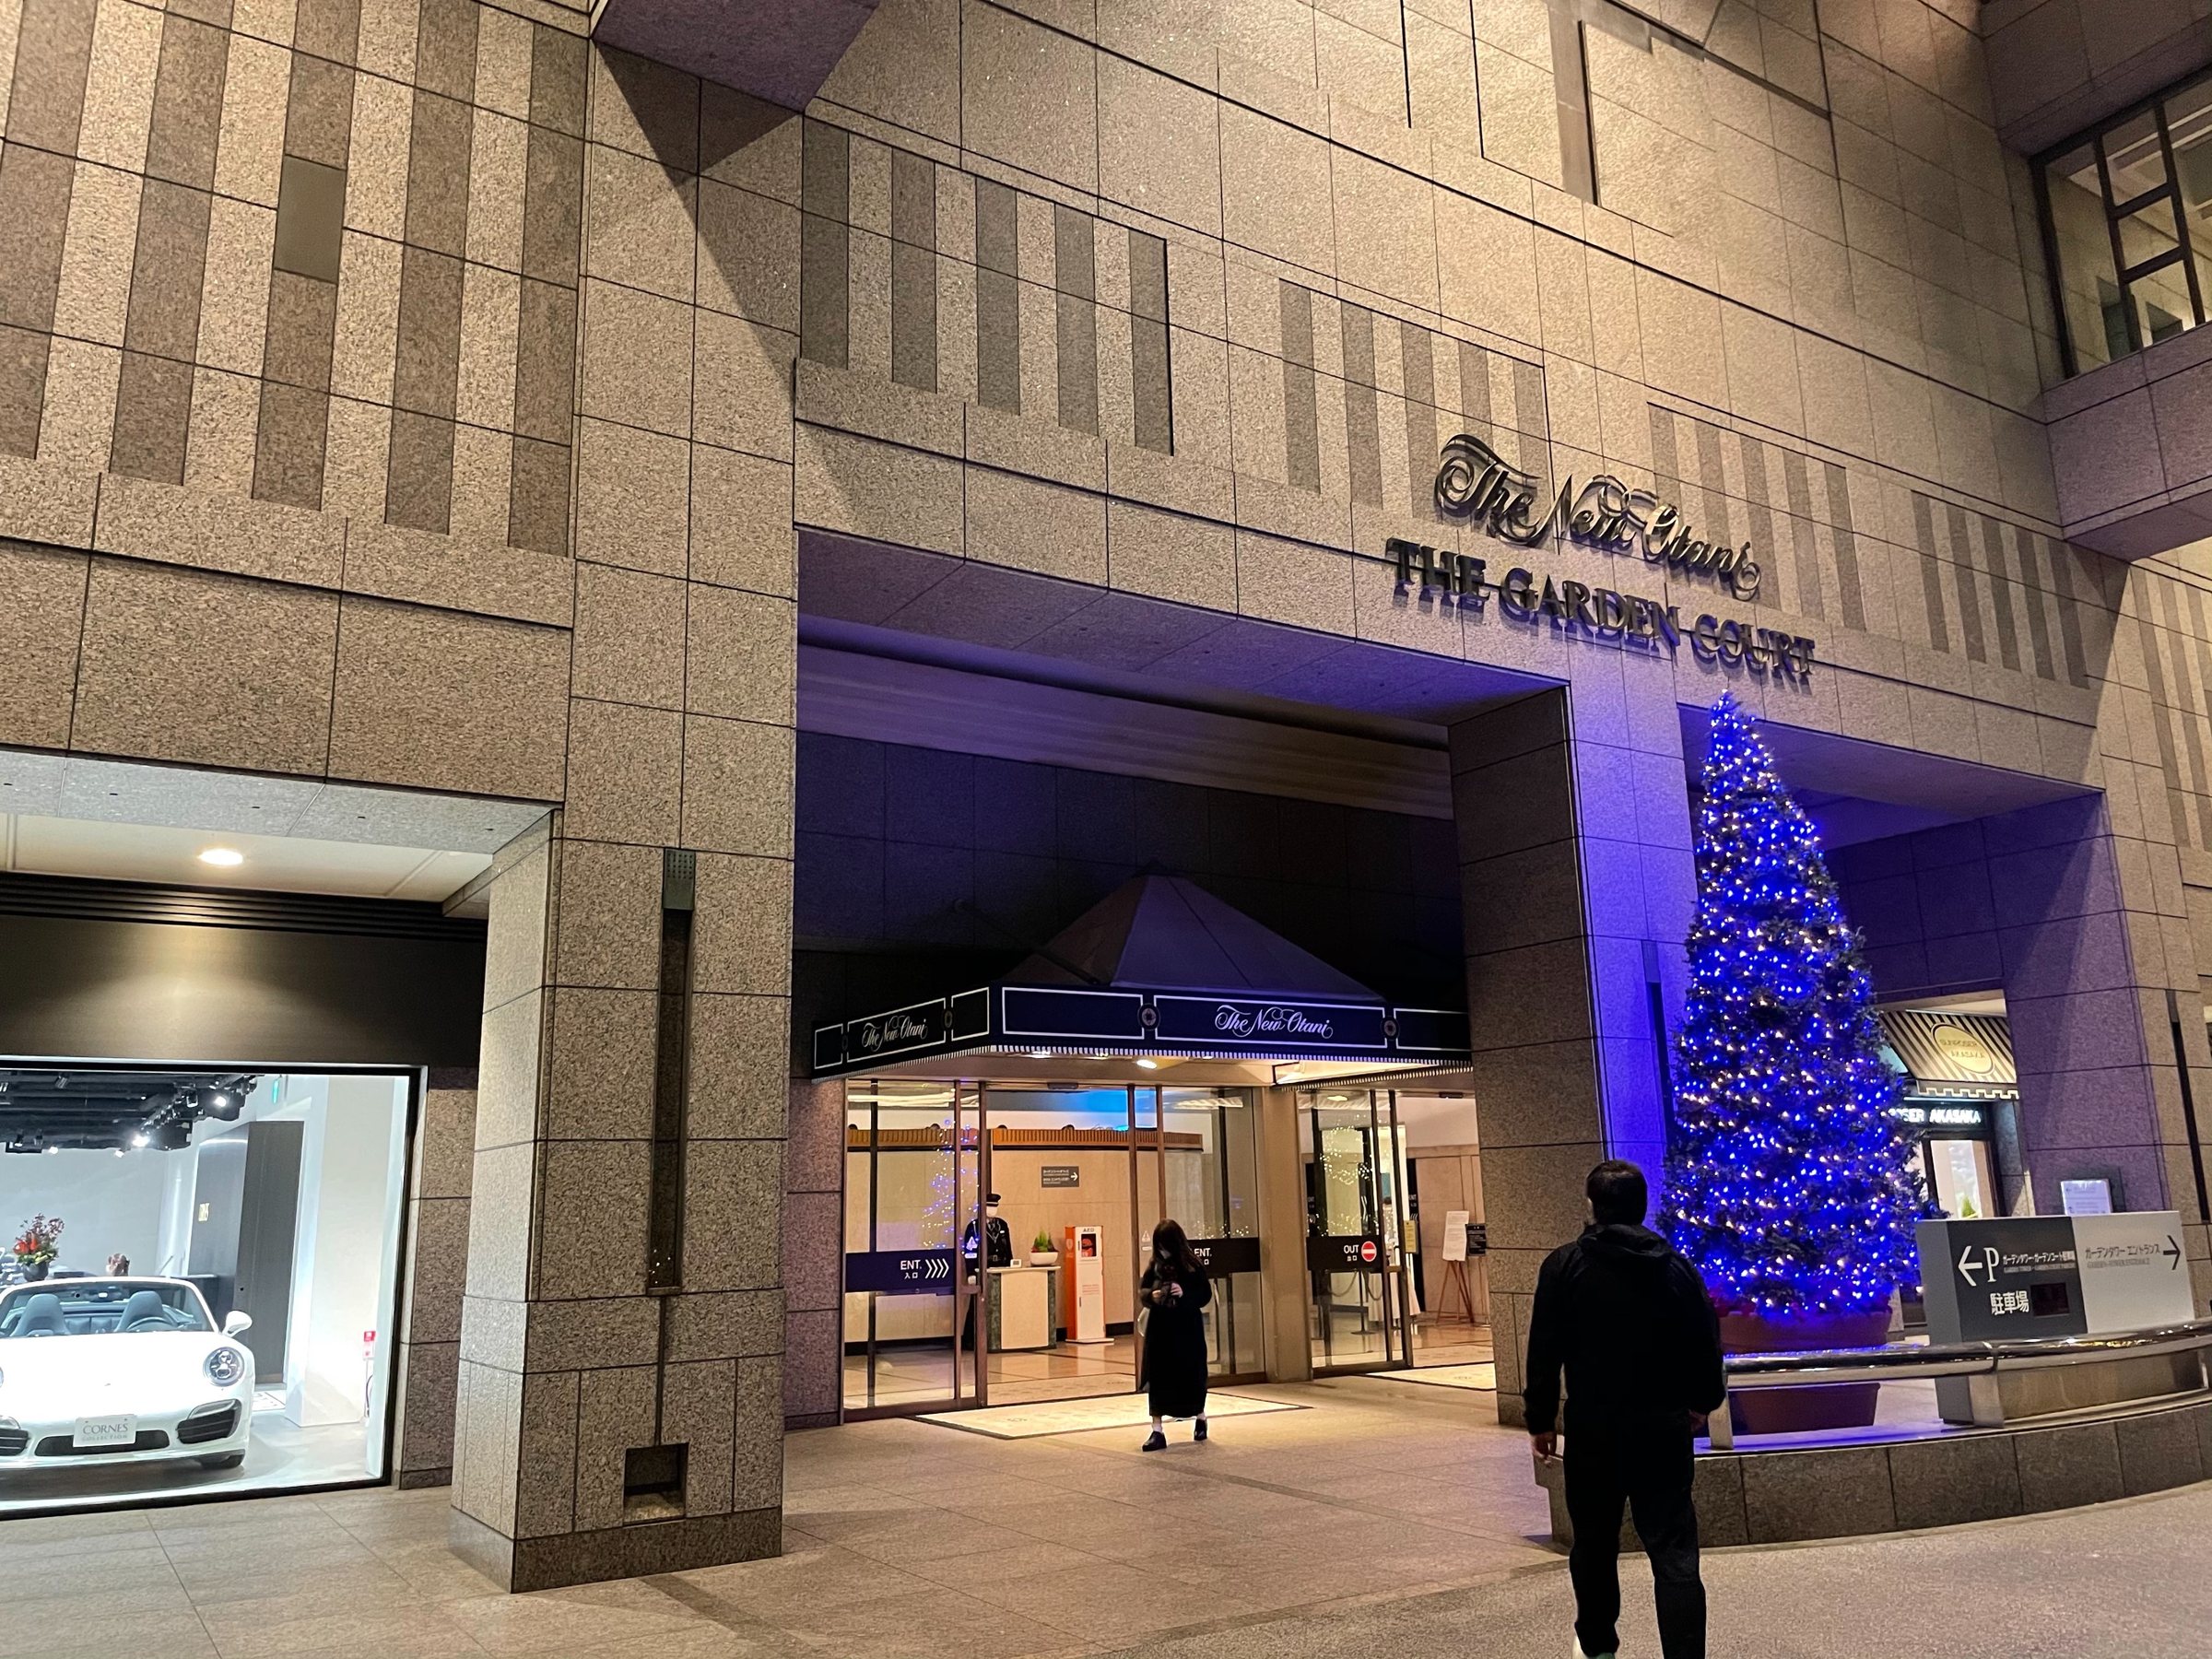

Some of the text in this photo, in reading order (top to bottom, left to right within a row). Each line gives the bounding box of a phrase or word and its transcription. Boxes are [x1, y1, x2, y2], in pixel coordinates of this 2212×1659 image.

[1435, 433, 1541, 518] The
[1641, 502, 1762, 601] Otani
[1385, 537, 1816, 675] THE GARDEN COURT
[862, 1022, 882, 1047] The
[898, 1016, 928, 1040] Otani
[1215, 1005, 1334, 1040] The New Otani
[1929, 1108, 1982, 1124] AKASAKA
[1343, 1244, 1359, 1254] OUT
[904, 1272, 919, 1280] 入口
[1983, 1247, 2000, 1283] P
[1990, 1290, 2030, 1316] 駐車場
[83, 1423, 128, 1434] CORNES
